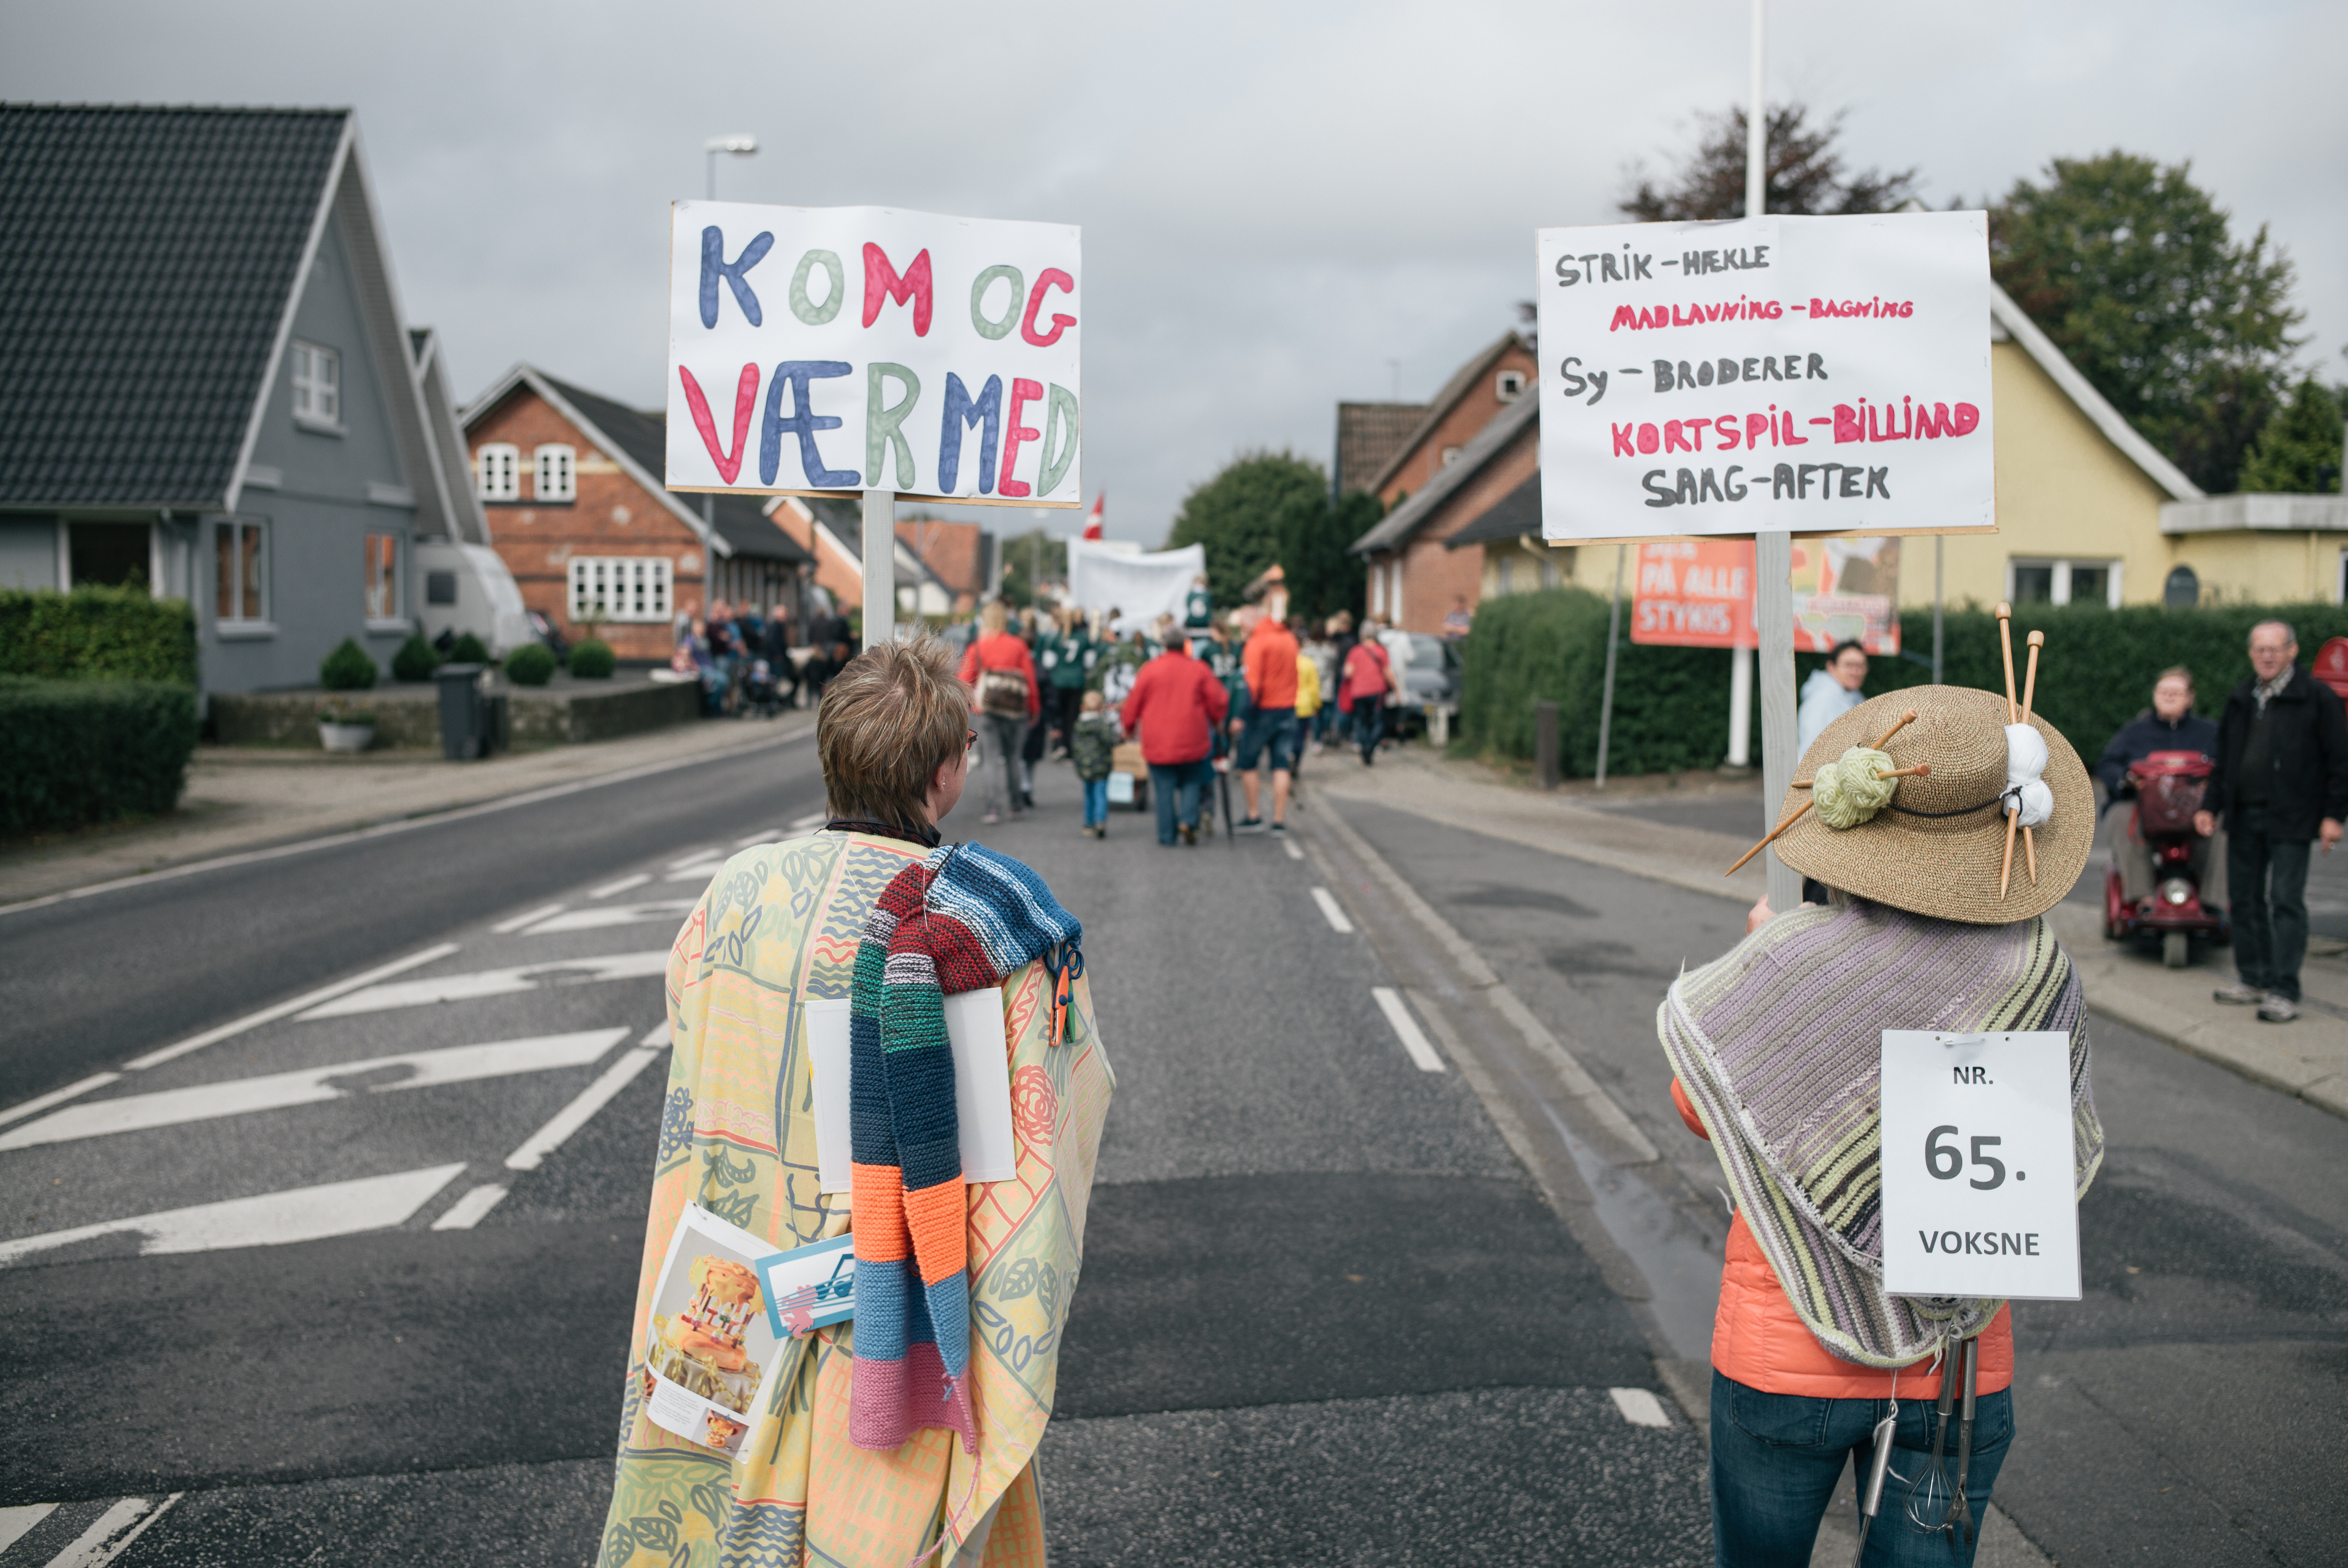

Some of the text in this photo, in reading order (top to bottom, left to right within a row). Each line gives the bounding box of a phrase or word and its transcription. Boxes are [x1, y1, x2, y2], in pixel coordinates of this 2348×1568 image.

[699, 225, 1077, 347] KOM OG
[679, 361, 1079, 498] VÆR MED
[1683, 564, 1748, 600] ALLE
[1953, 1066, 1994, 1084] NR.
[1924, 1125, 2026, 1190] 65.
[1919, 1230, 2040, 1256] VOKSNE
